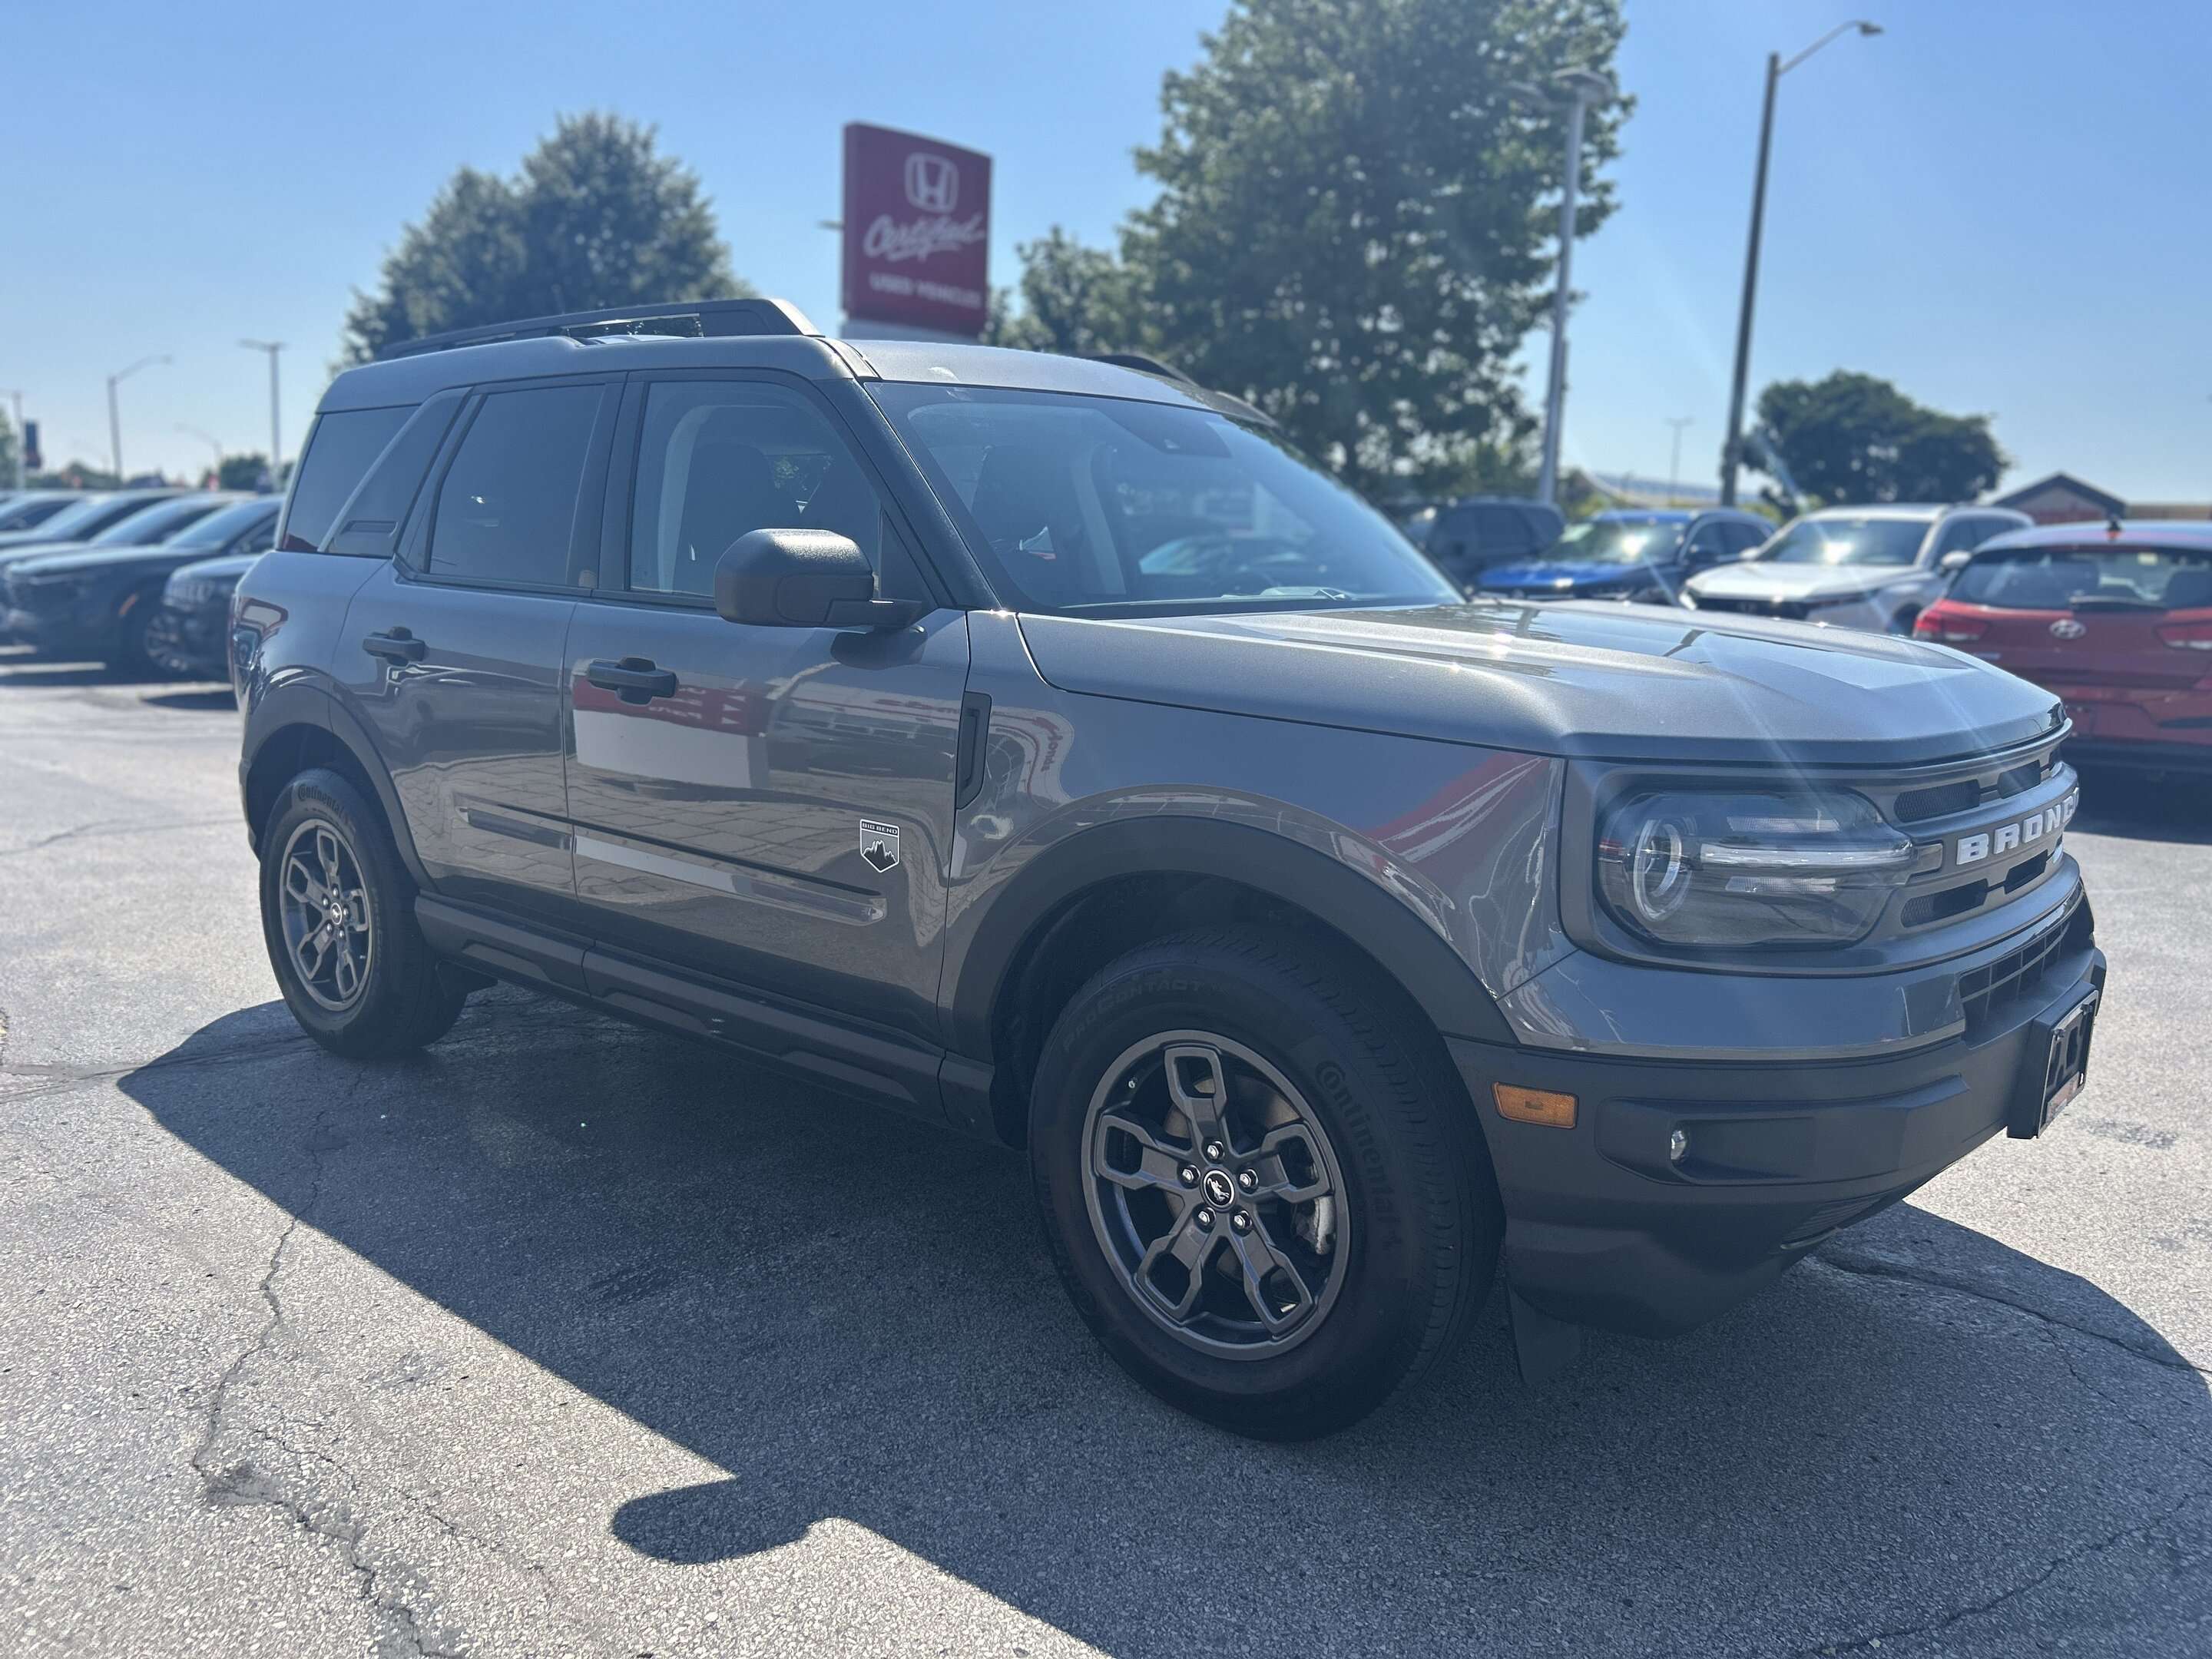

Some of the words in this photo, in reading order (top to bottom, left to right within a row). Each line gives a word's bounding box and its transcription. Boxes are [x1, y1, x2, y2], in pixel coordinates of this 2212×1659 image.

[876, 826, 898, 835] BEND
[1956, 787, 2080, 865] BRONC
[1316, 1060, 1400, 1224] Continental
